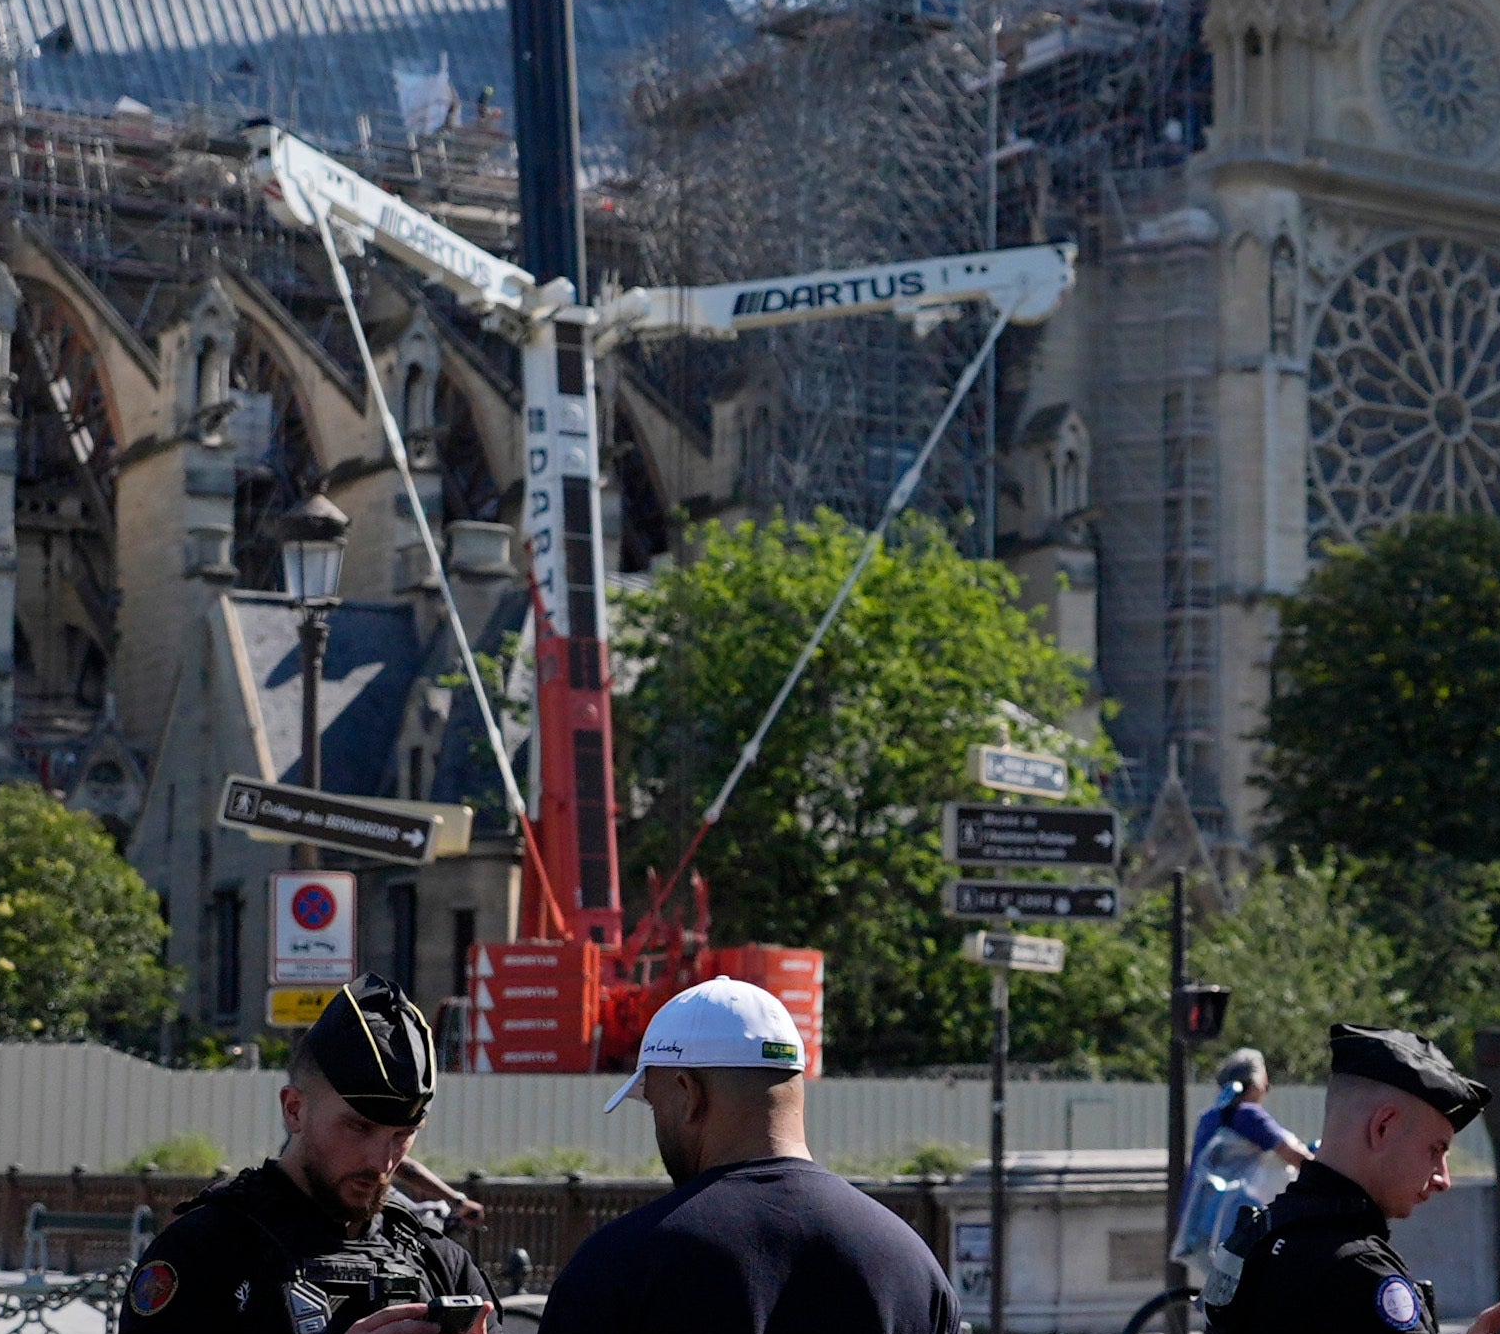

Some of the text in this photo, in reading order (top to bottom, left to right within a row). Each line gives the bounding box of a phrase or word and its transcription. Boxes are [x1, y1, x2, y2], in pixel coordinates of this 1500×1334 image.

[399, 215, 492, 288] DARTUS
[761, 271, 926, 312] DARTUS
[325, 813, 400, 842] BERNARDINS
